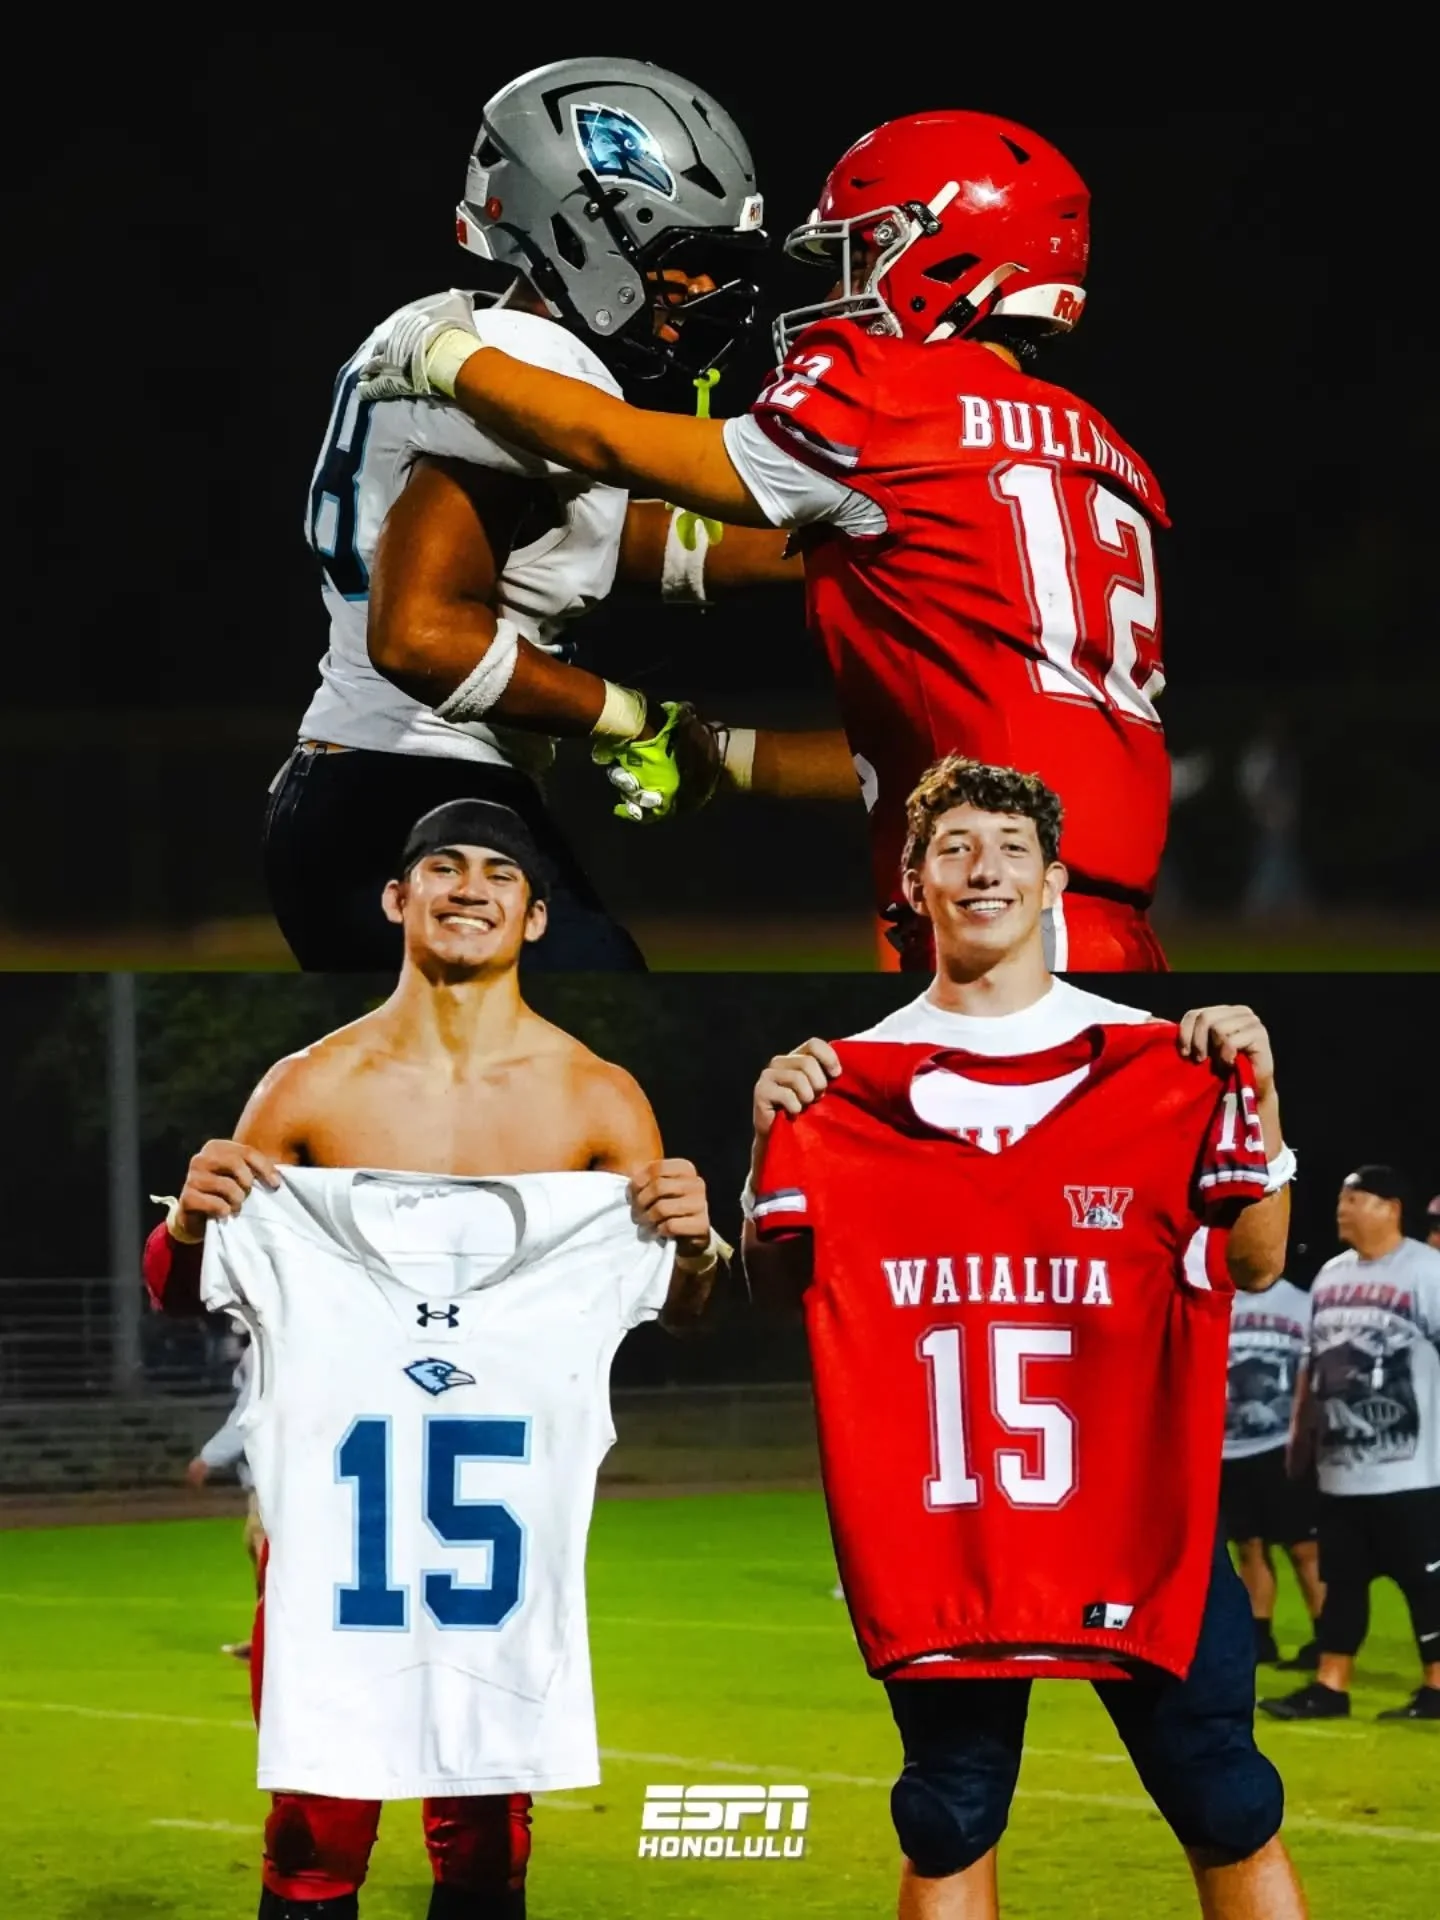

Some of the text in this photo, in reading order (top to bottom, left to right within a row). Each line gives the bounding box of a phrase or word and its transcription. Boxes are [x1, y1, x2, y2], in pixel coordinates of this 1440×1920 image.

[988, 459, 1166, 733] 12
[1216, 1086, 1265, 1152] 15
[1063, 1184, 1134, 1230] W
[881, 1256, 1112, 1306] WAIALUA
[916, 1323, 1079, 1512] 15
[333, 1414, 532, 1632] 15
